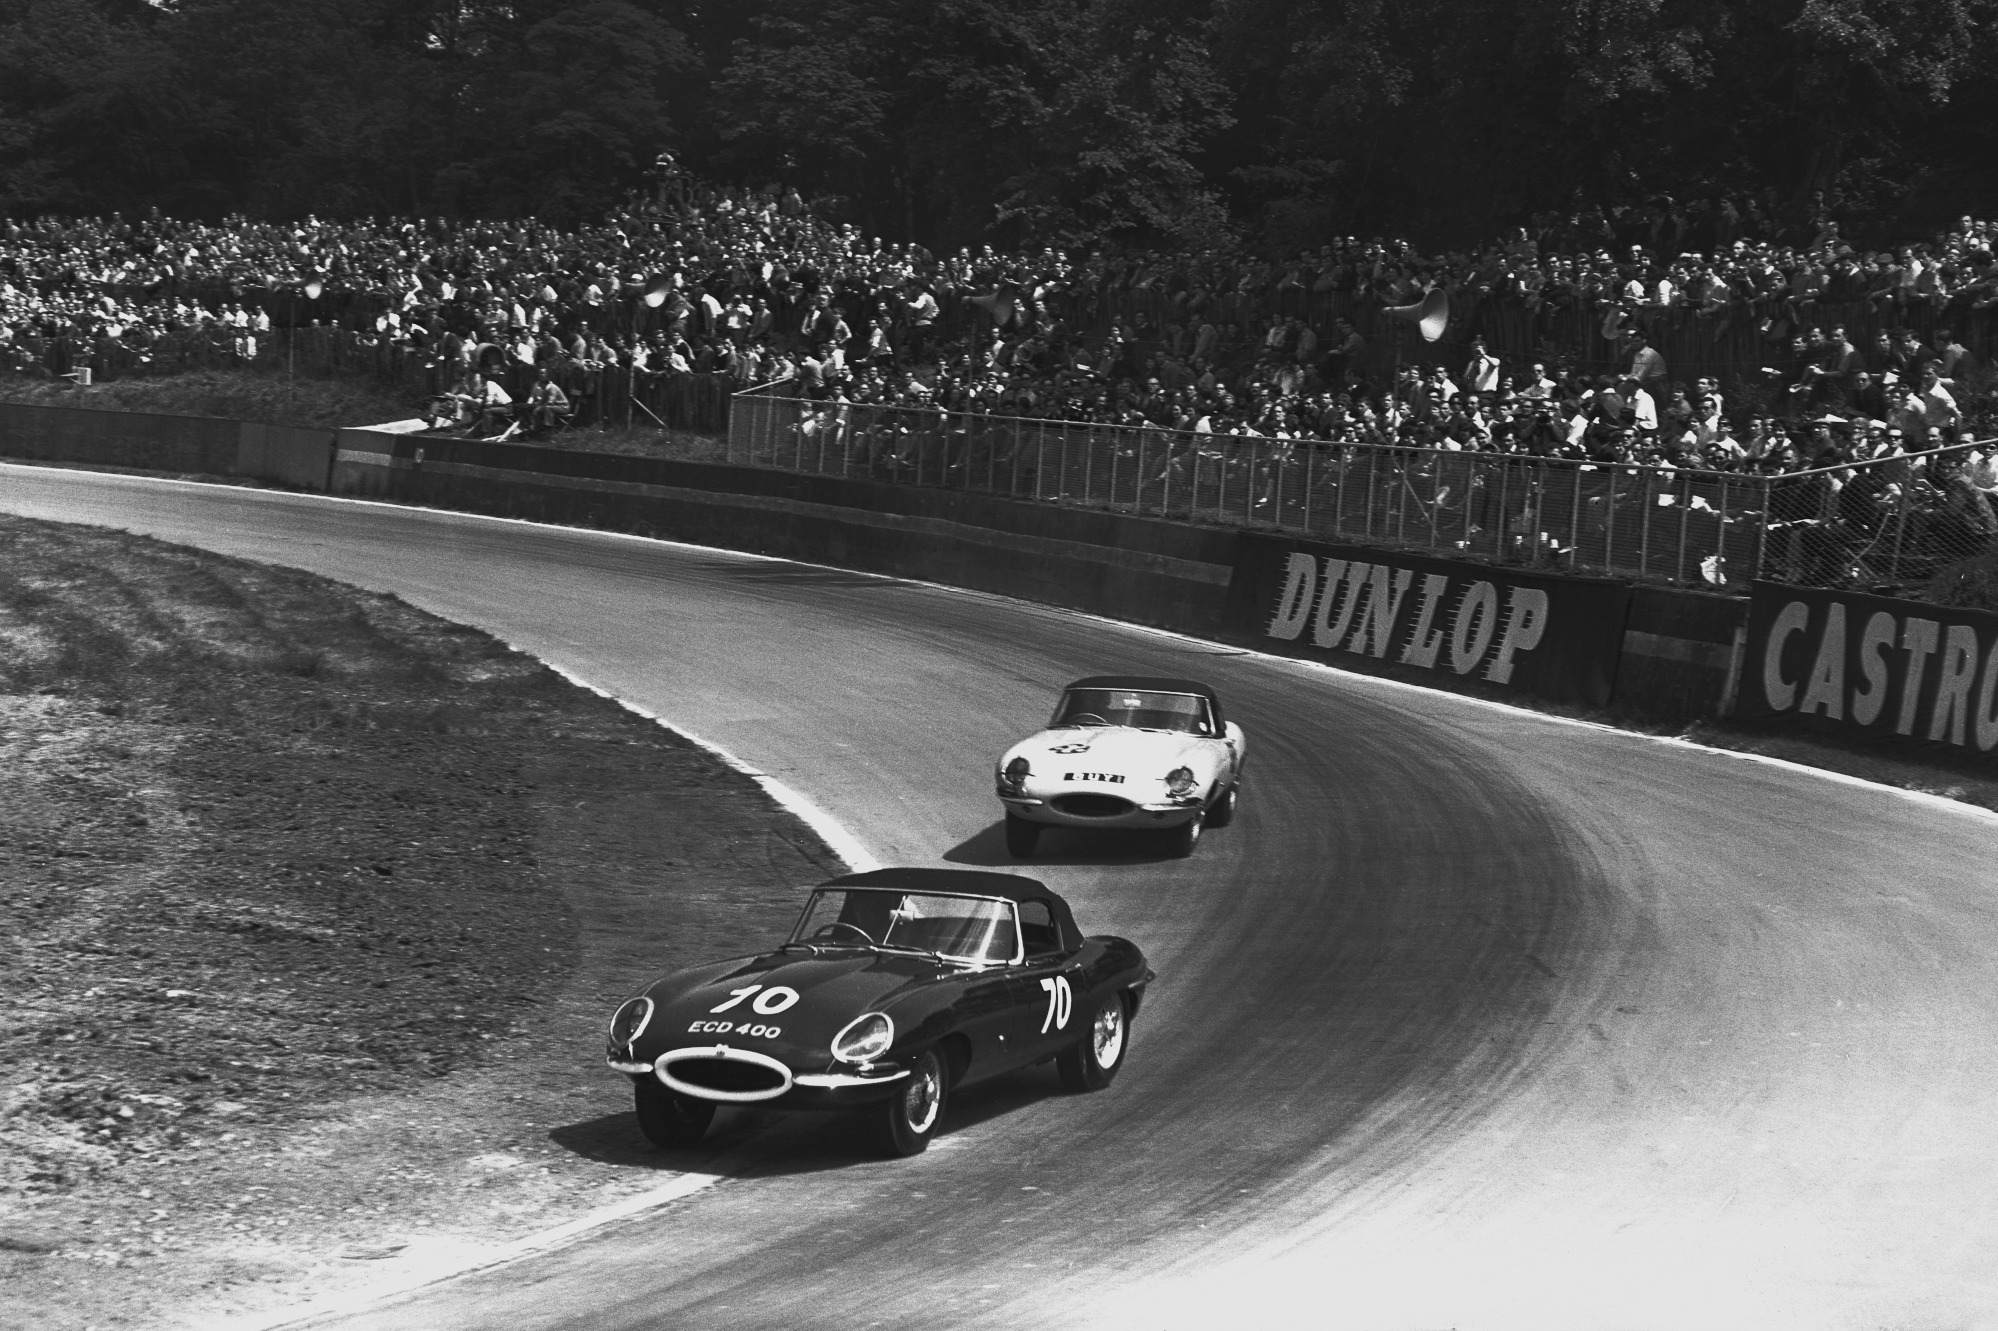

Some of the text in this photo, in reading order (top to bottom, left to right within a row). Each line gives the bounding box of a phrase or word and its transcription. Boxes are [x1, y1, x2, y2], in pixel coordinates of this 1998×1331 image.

[1264, 552, 1549, 685] DUNLOP
[709, 984, 800, 1015] 70
[1040, 975, 1072, 1034] 70
[688, 1021, 781, 1039] ECD 400
